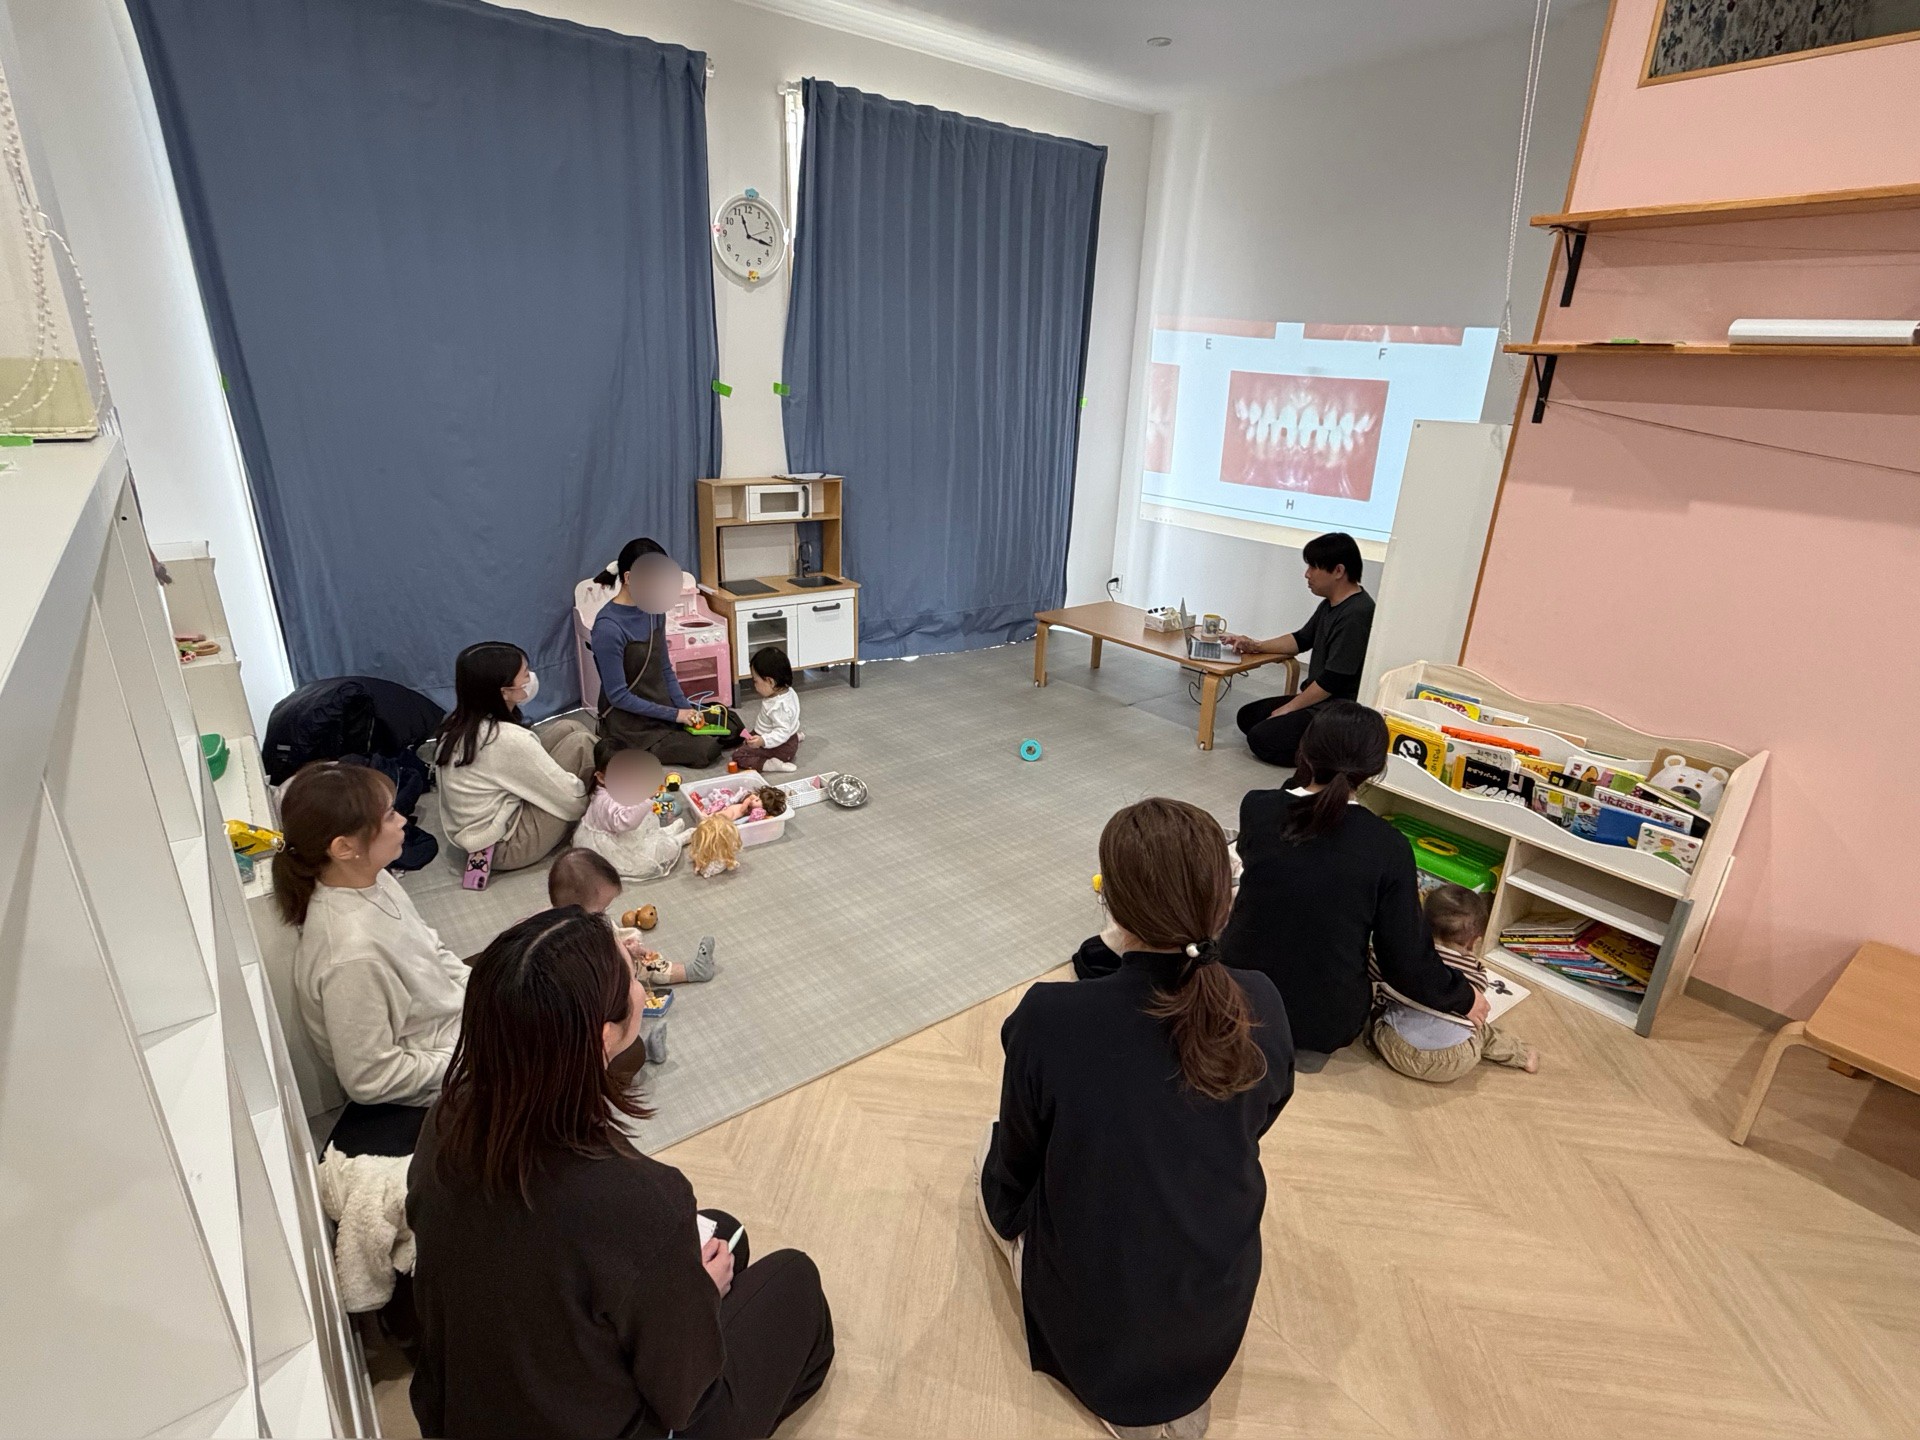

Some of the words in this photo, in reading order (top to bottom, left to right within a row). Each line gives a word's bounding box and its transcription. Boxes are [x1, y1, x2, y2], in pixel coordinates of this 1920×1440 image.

[733, 207, 741, 216] 11
[744, 206, 752, 214] 12
[726, 217, 734, 226] 10
[1205, 338, 1212, 350] E
[1378, 348, 1388, 360] F
[1285, 498, 1295, 511] H
